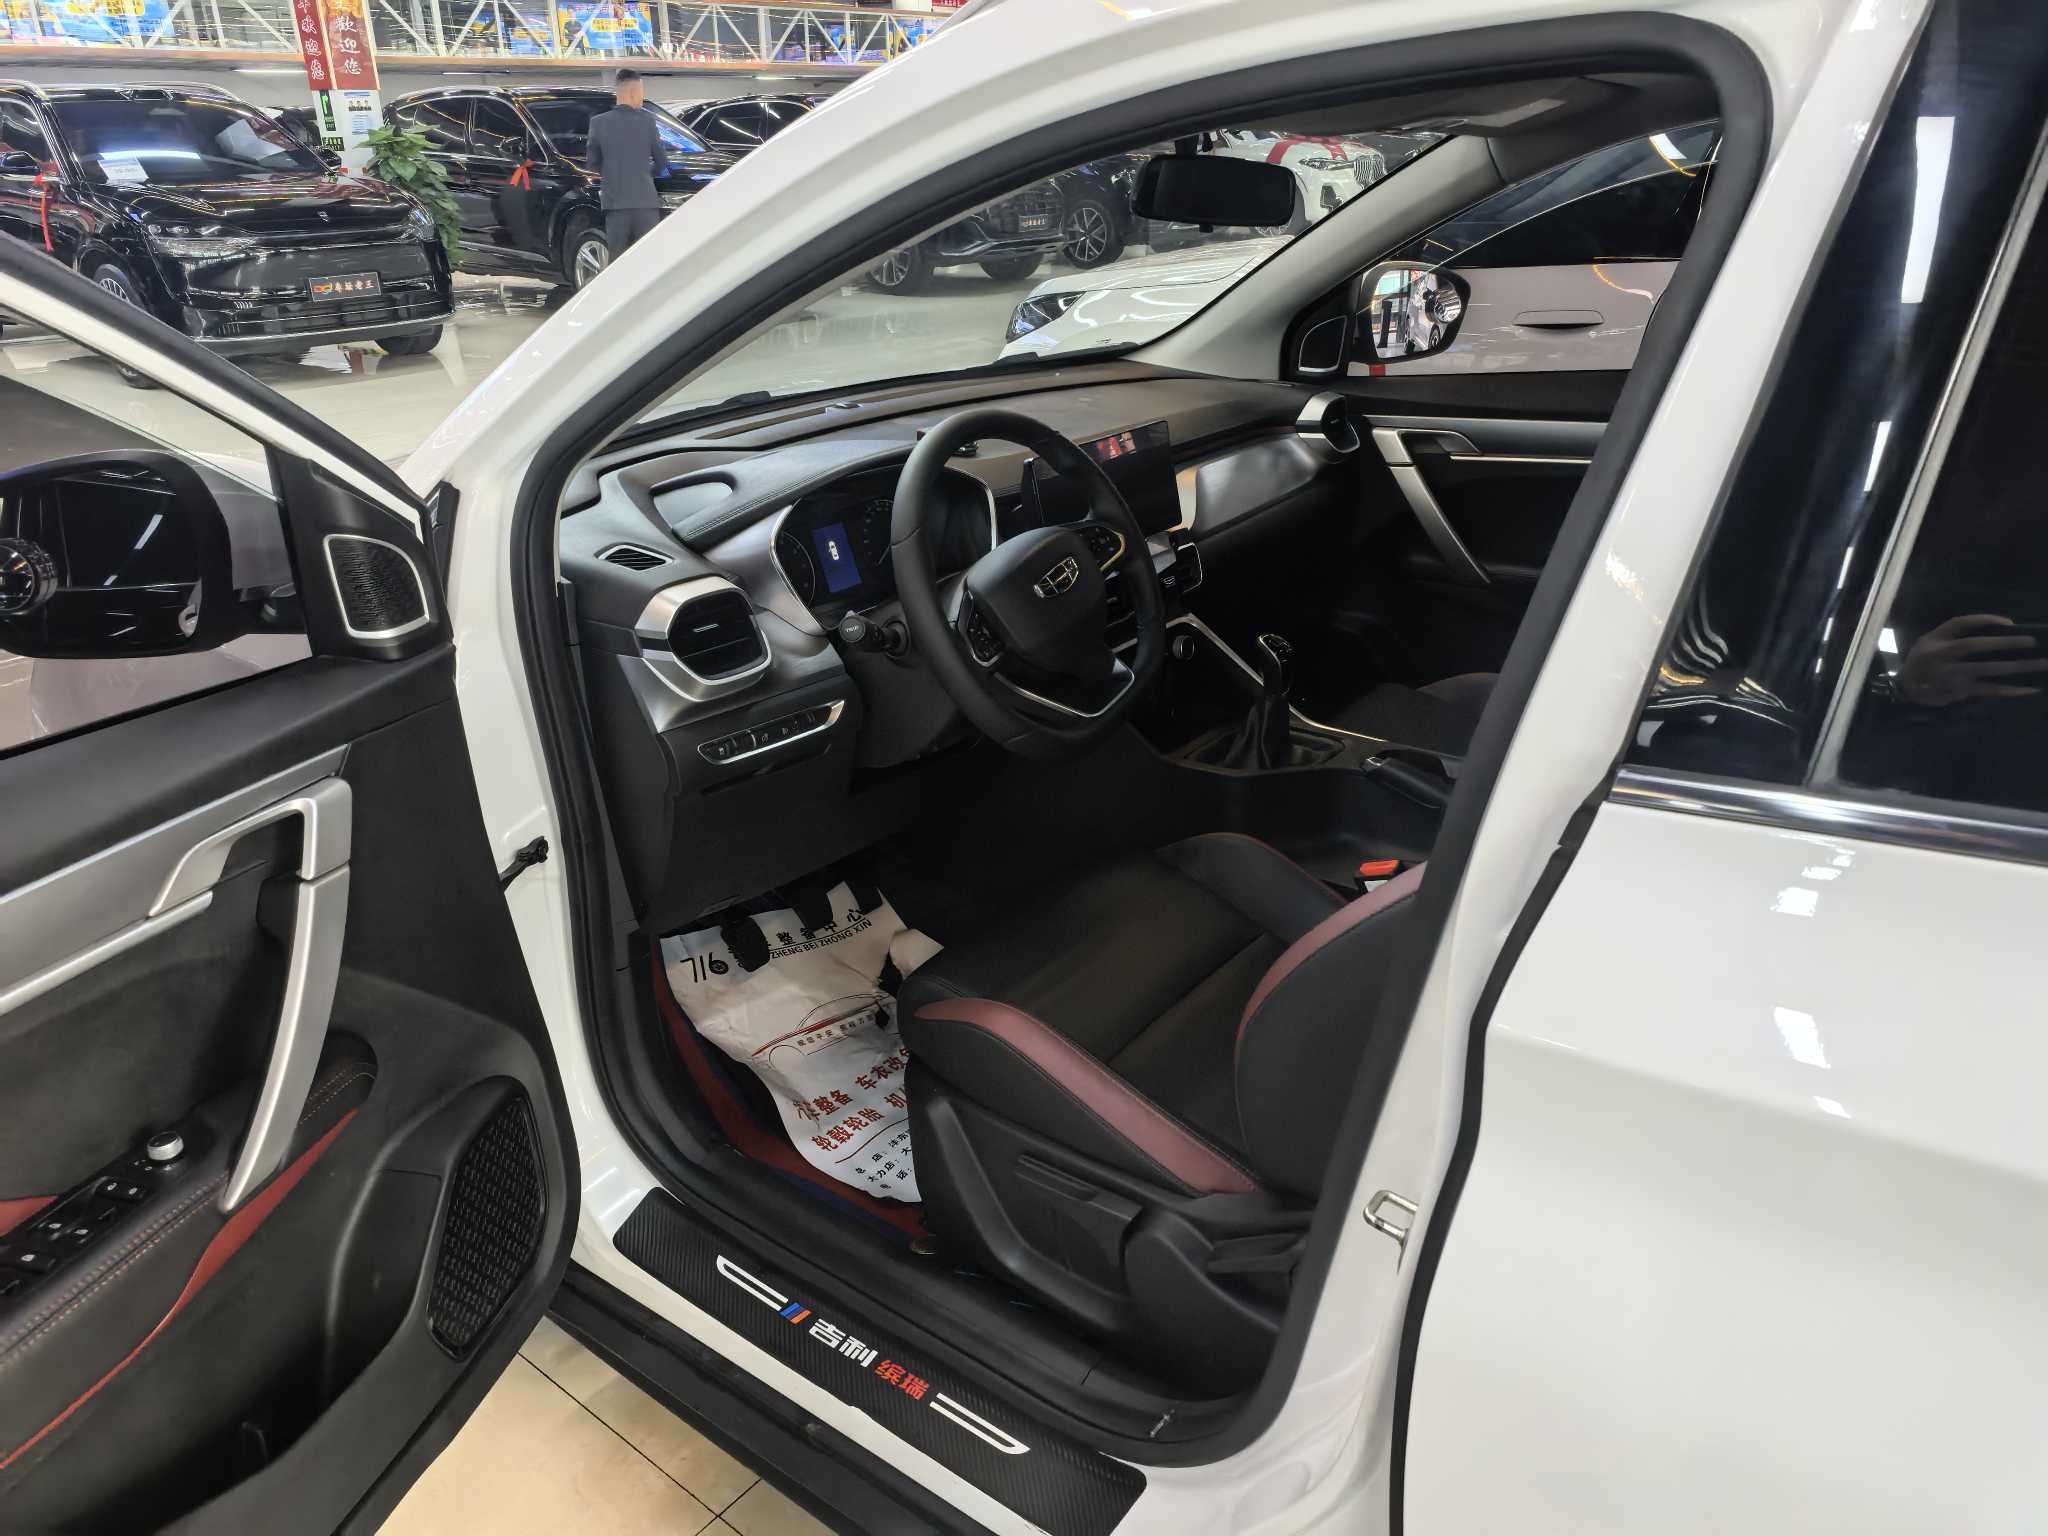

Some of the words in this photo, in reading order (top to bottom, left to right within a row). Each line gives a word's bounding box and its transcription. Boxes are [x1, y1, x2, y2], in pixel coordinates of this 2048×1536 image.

[769, 945, 802, 959] ZHENG
[802, 941, 818, 953] BEI
[820, 931, 854, 948] ZHONG
[852, 919, 873, 935] XIN
[680, 951, 729, 983] 716
[811, 1107, 885, 1152] 轮毂轮胎
[884, 1087, 907, 1109] 机
[808, 1317, 879, 1368] 吉利
[873, 1358, 930, 1400] 缤瑞
